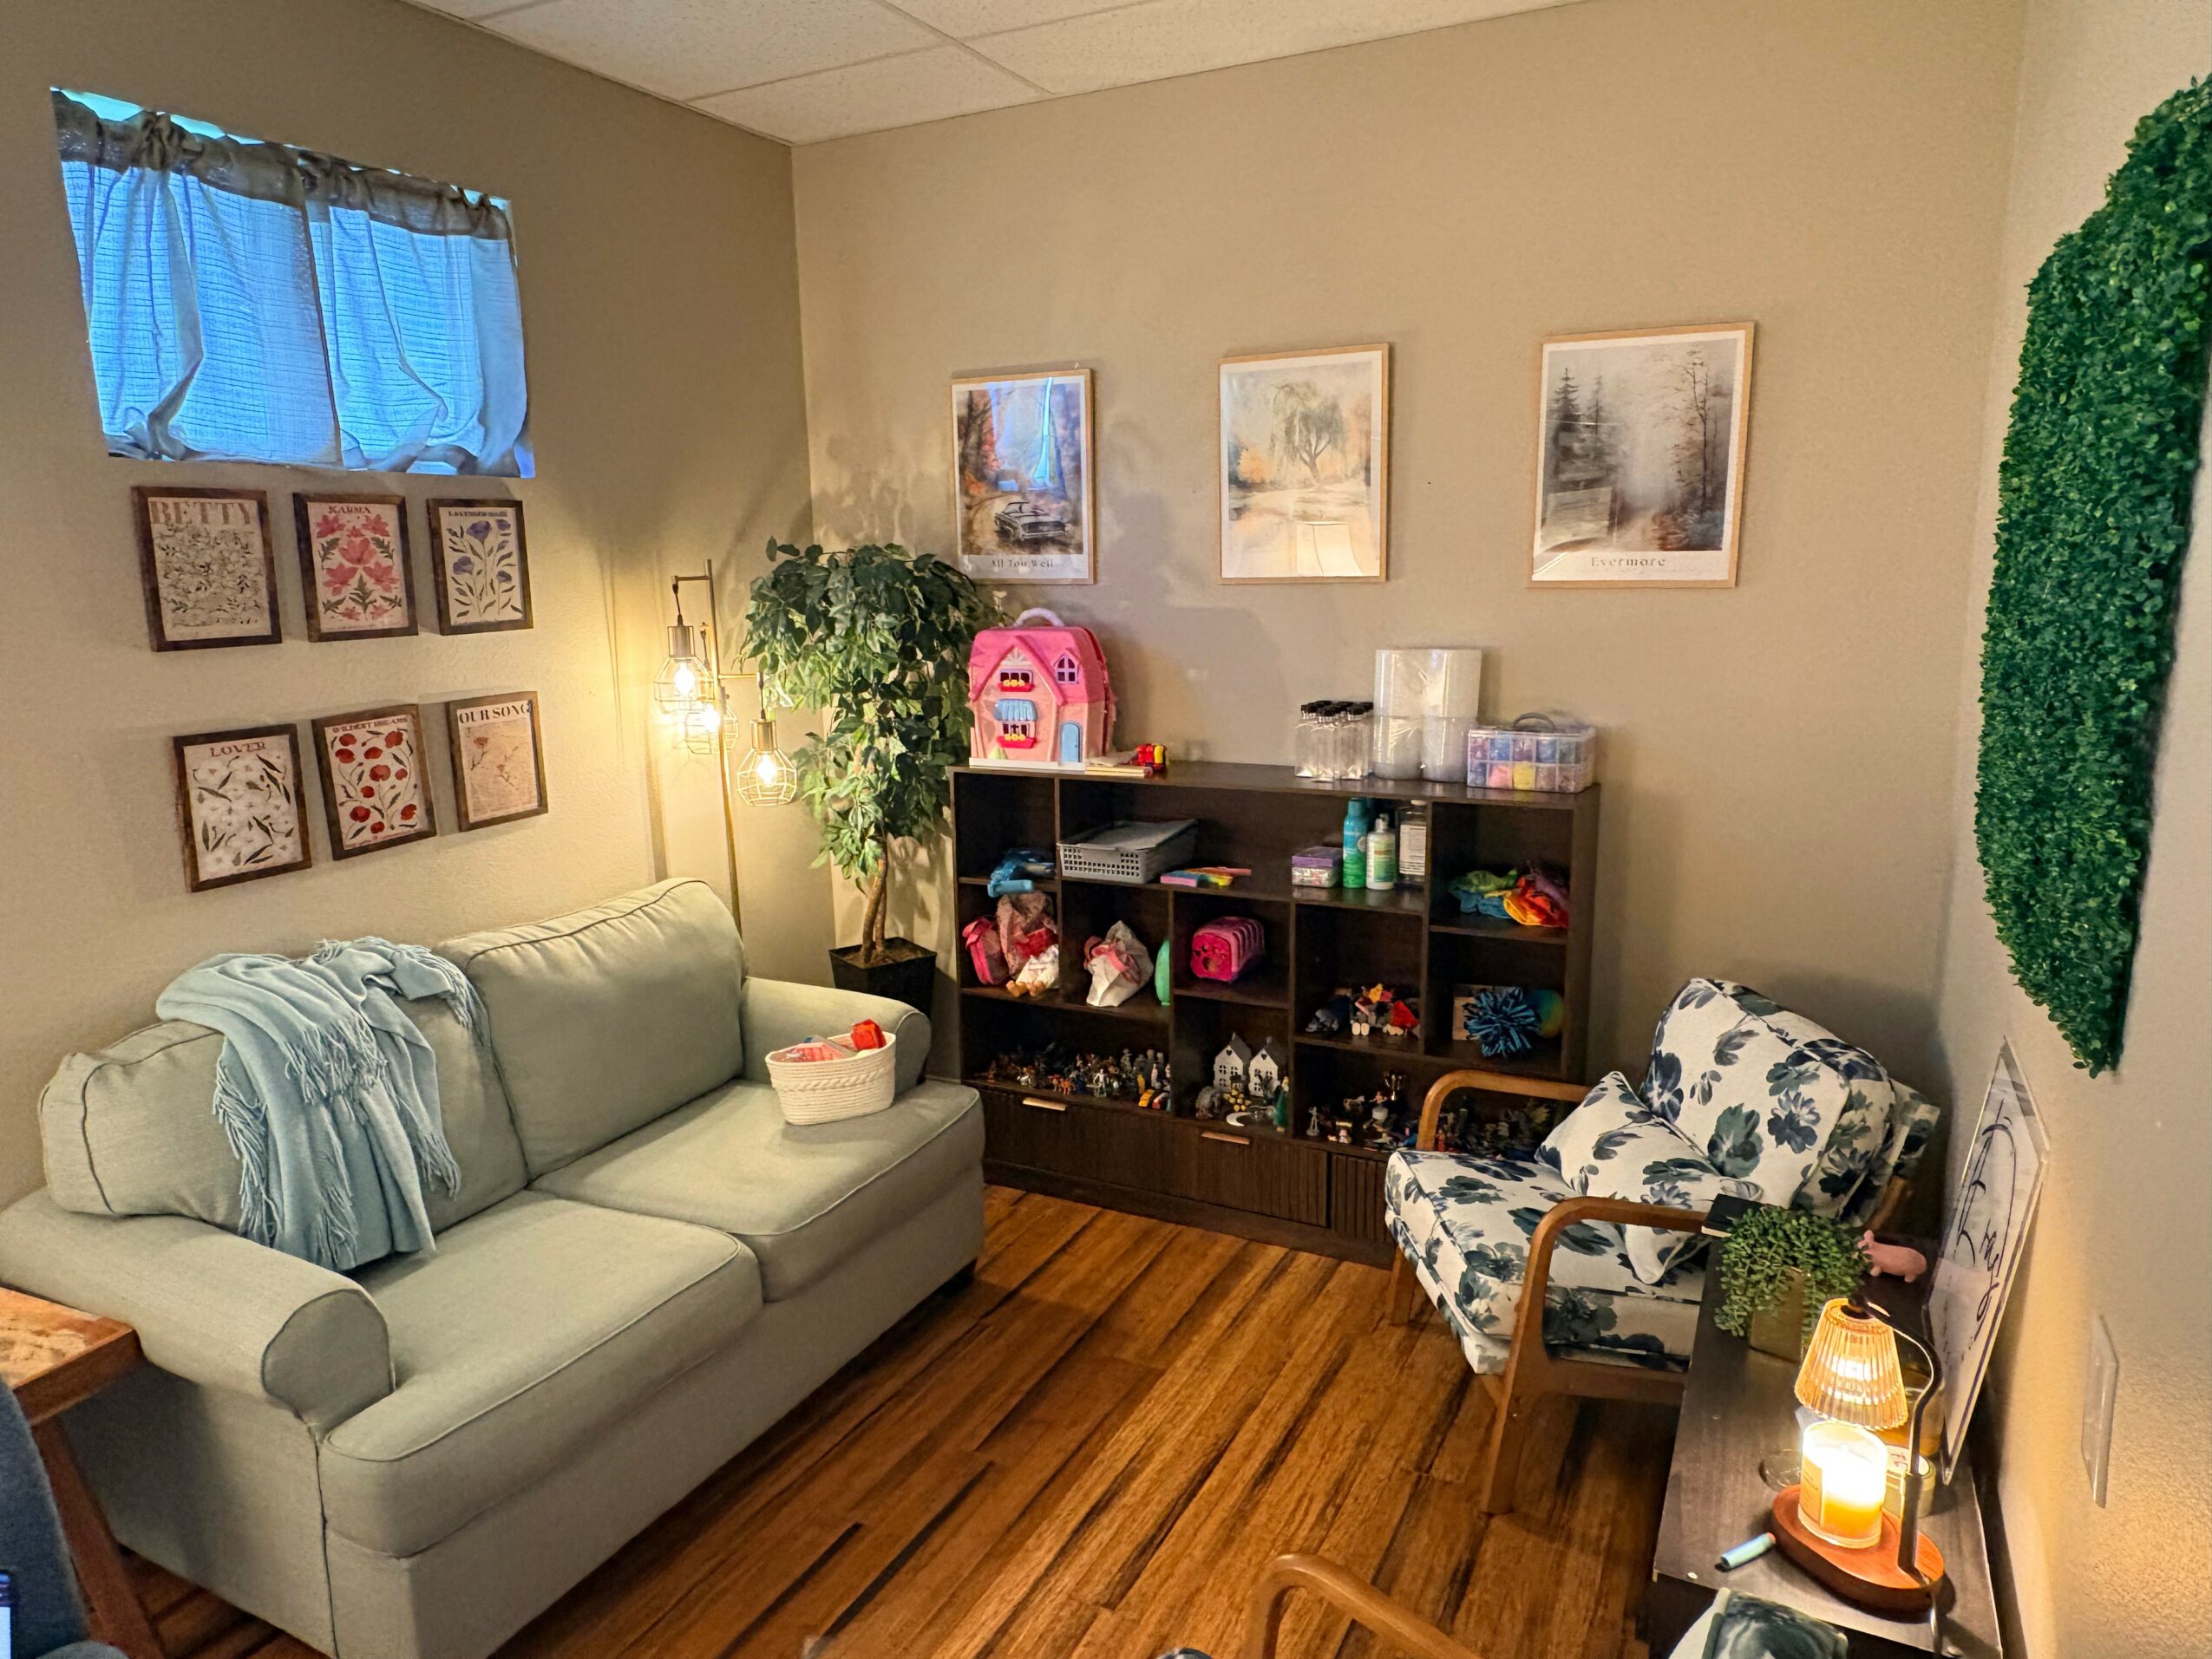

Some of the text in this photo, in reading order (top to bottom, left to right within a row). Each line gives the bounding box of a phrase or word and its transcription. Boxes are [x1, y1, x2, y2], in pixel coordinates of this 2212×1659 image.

[149, 500, 252, 525] BETTY
[1591, 557, 1666, 566] Evermore
[459, 709, 490, 723] OUR
[210, 741, 266, 757] LOVER
